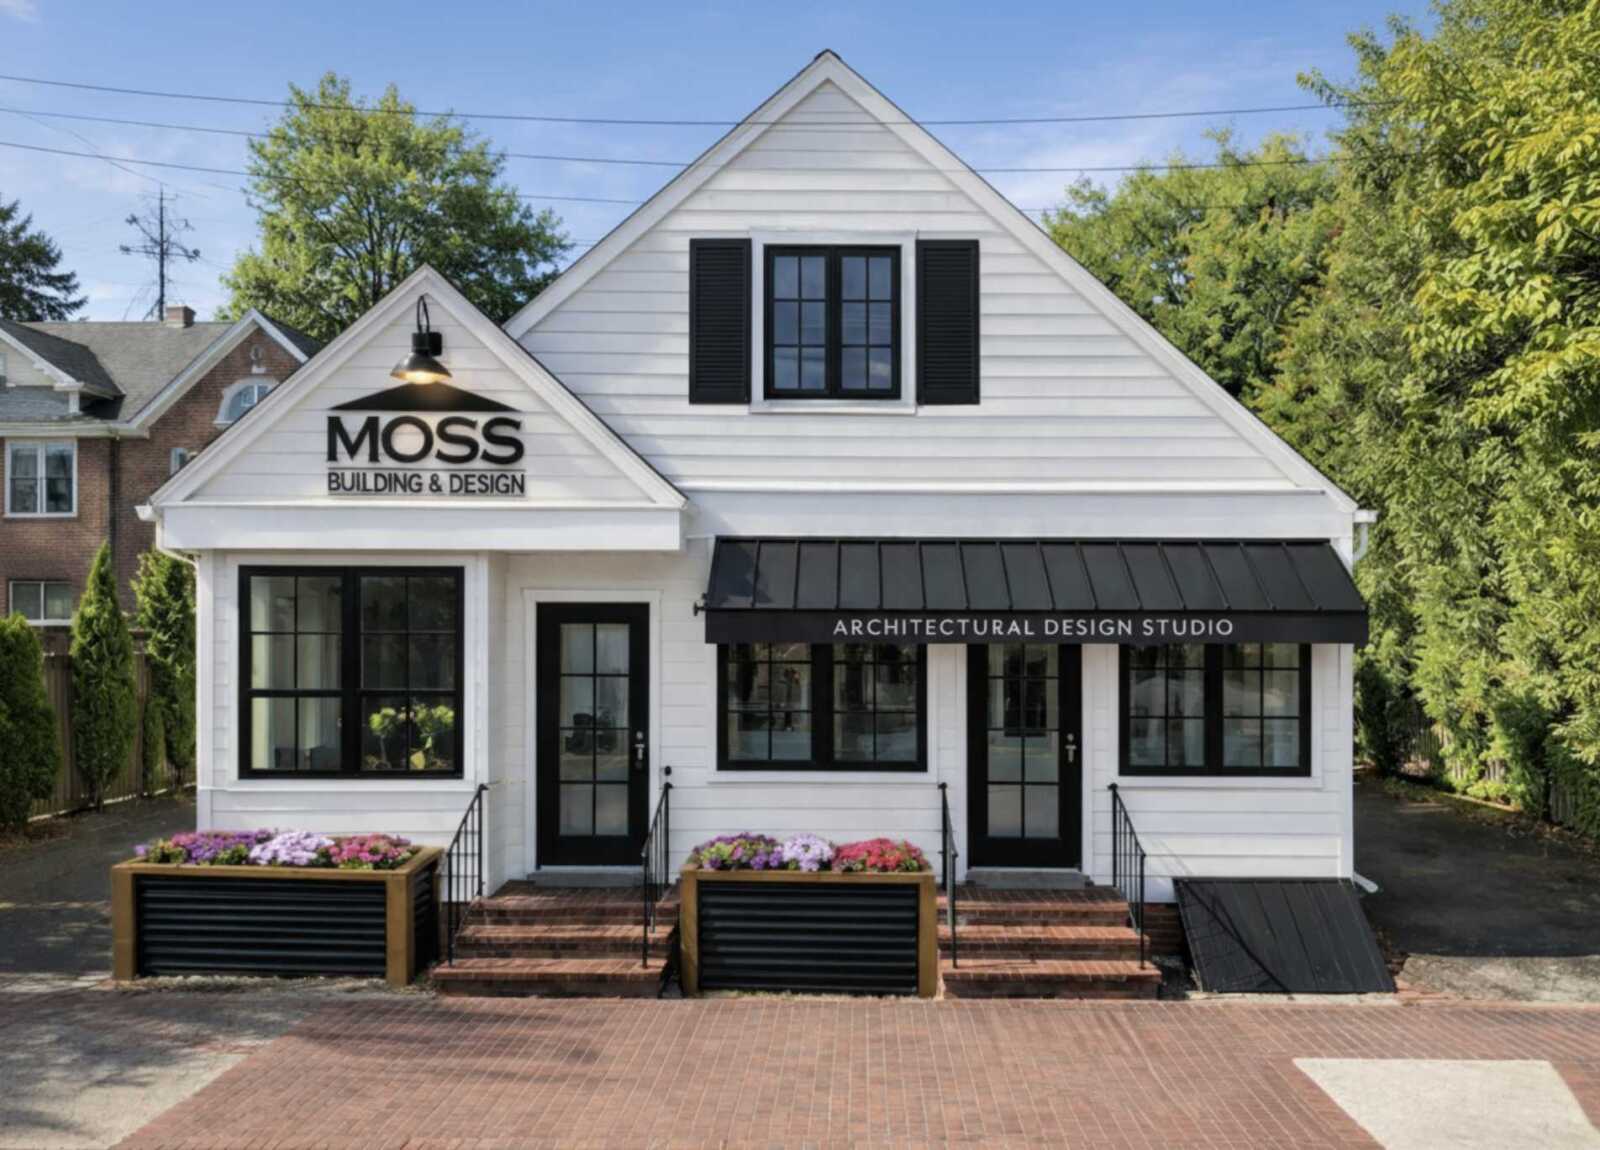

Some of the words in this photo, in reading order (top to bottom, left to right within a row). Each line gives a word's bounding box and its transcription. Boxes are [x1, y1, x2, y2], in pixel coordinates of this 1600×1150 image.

[326, 415, 525, 465] MOSS
[328, 472, 422, 492] BUILDING
[429, 473, 442, 492] &
[450, 474, 525, 494] DESIGN
[833, 619, 1034, 636] ARCHITECTURAL
[1044, 619, 1132, 636] DESIGN
[1142, 619, 1234, 636] STUDIO
